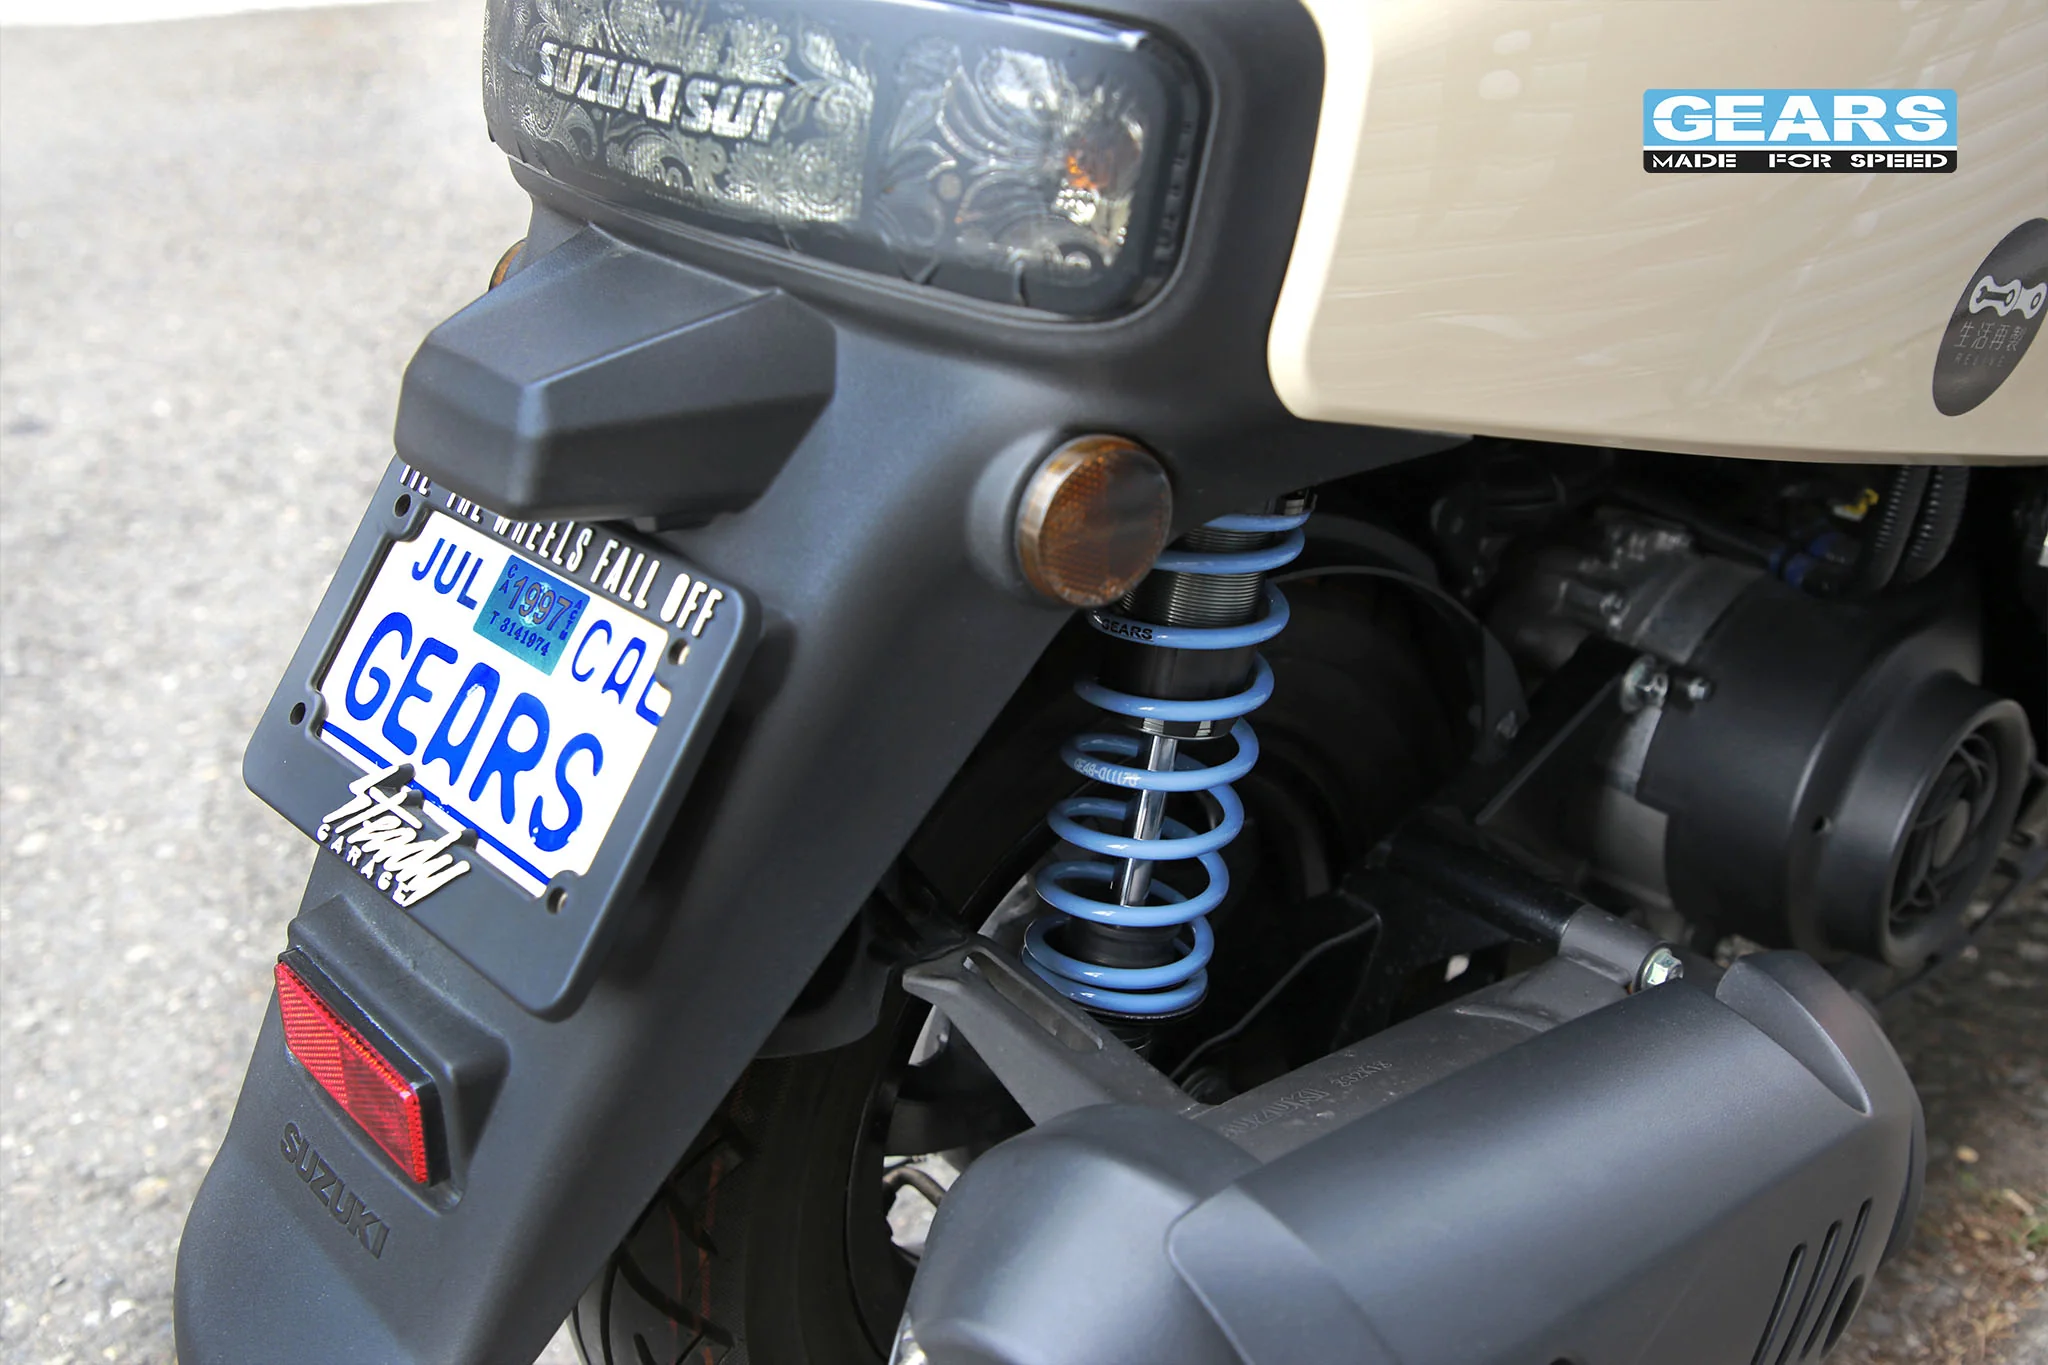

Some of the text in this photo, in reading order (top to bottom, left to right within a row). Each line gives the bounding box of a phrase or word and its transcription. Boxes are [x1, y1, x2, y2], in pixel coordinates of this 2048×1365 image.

[537, 41, 681, 124] SUZUKI
[412, 538, 484, 610] JUL
[508, 575, 574, 632] 1997
[590, 539, 661, 609] FALL
[660, 573, 724, 637] OFF
[1101, 618, 1153, 640] GEARS
[345, 611, 604, 852] GEARS
[280, 1121, 391, 1260] SUZUKI
